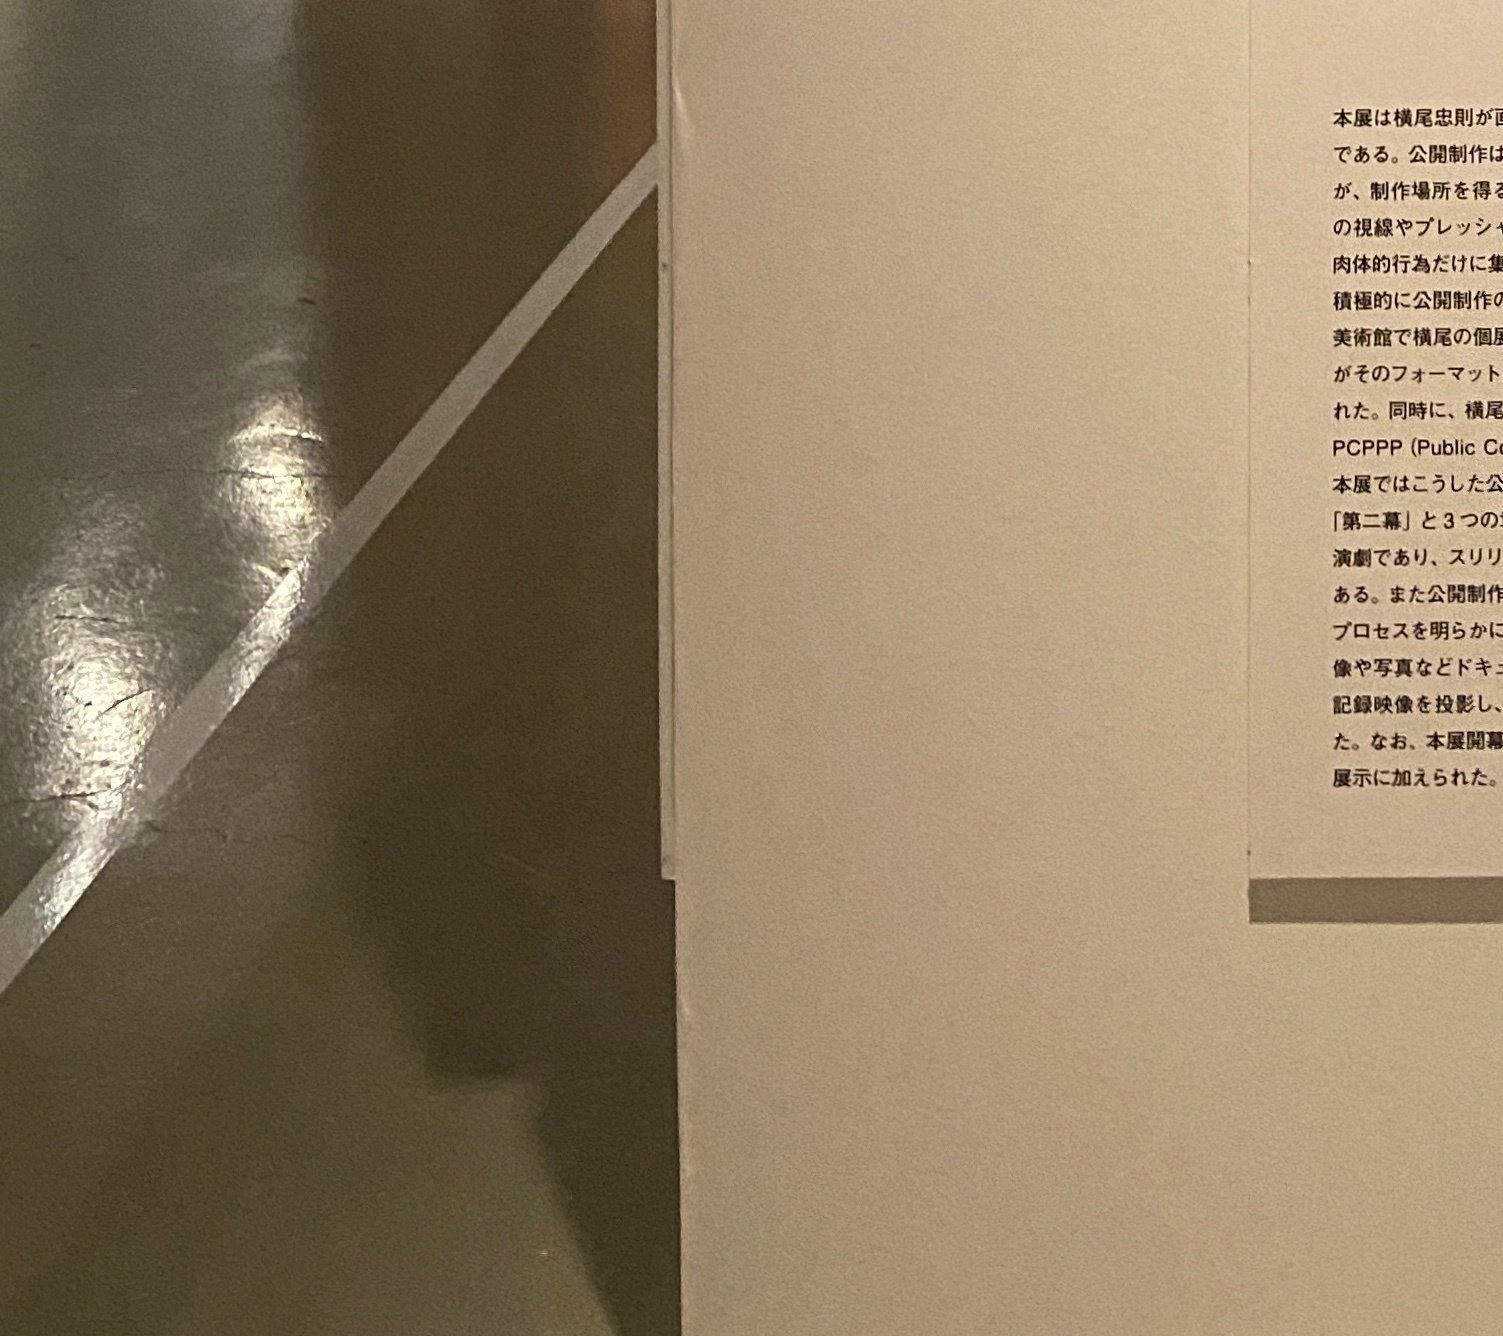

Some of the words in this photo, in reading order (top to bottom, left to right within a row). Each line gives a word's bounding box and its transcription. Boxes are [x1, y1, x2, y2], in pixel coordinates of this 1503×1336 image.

[1333, 438, 1403, 457] PCPPP
[1411, 437, 1476, 458] (Public
[1333, 767, 1497, 789] 展示に加えられた。
